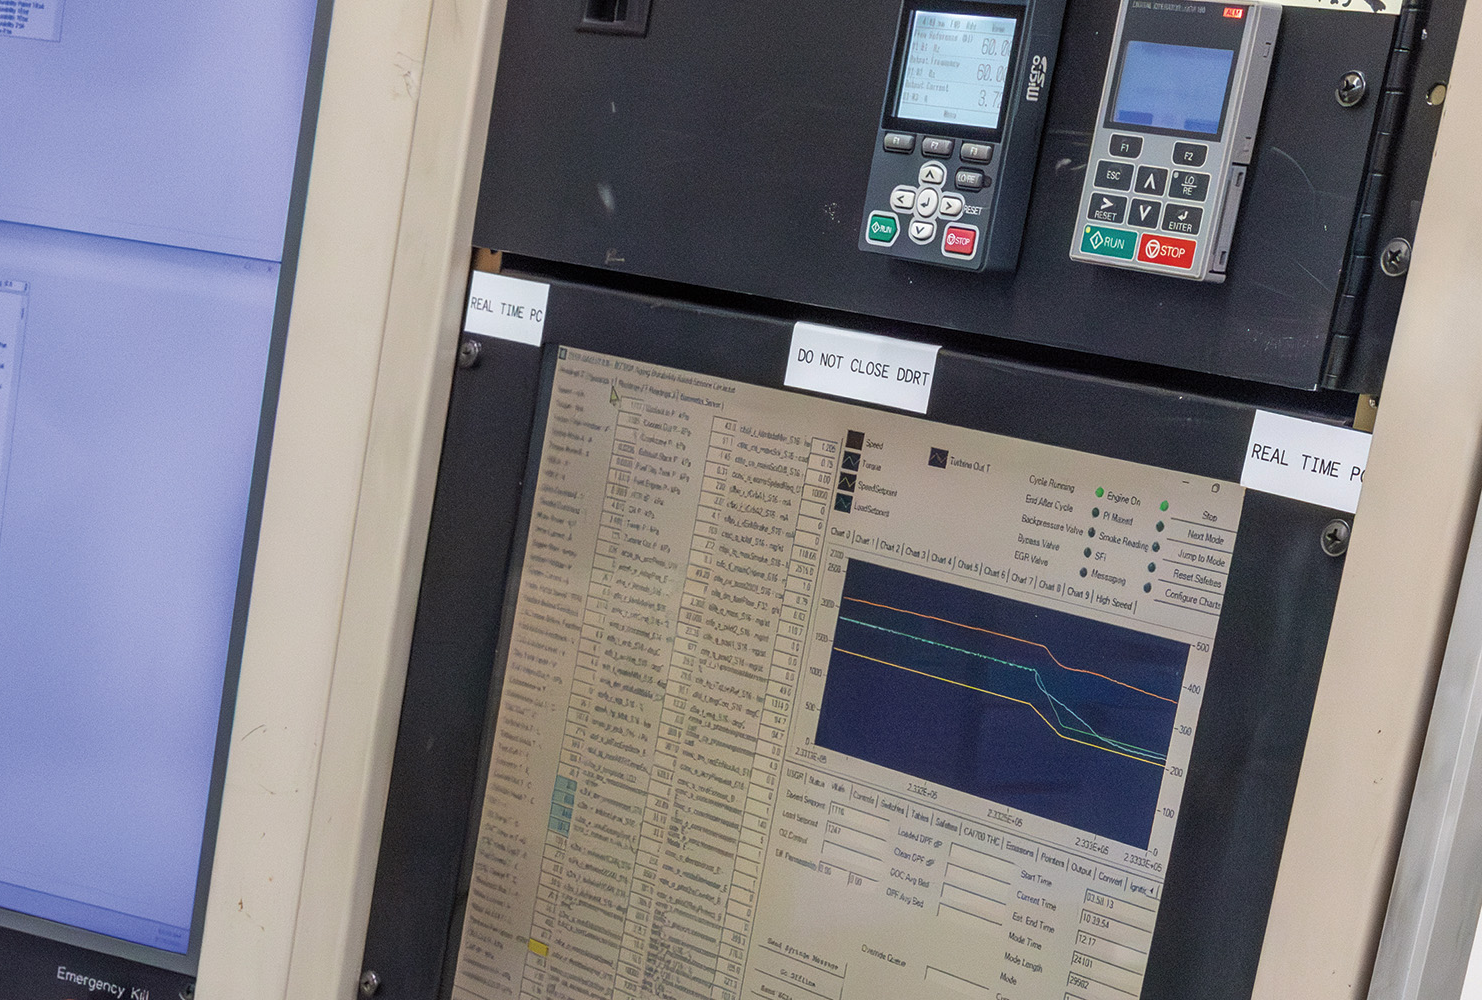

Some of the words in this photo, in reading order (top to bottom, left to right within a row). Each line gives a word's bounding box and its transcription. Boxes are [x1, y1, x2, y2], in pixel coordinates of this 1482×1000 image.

[893, 137, 900, 145] F1
[970, 147, 978, 155] F3
[1121, 144, 1129, 152] F1
[1184, 152, 1193, 160] F2
[1107, 171, 1121, 181] ESC
[1184, 176, 1195, 185] LO
[1182, 186, 1192, 196] RE
[964, 201, 982, 215] RESET
[1094, 210, 1117, 221] RESET
[880, 223, 891, 233] RUN
[1169, 222, 1192, 232] ENTER
[955, 236, 970, 245] STOP
[1104, 236, 1125, 249] RUN
[1160, 246, 1185, 258] STOP
[469, 296, 494, 314] REAL
[501, 302, 524, 319] TIME
[530, 307, 544, 324] PC
[797, 347, 815, 364] DO
[819, 352, 843, 370] NOT
[850, 358, 889, 379] CLOSE
[895, 367, 930, 387] DDRT
[866, 439, 884, 450] Speed
[862, 459, 881, 472] Torque
[1251, 443, 1289, 468] REAL
[1301, 453, 1341, 478] TIME
[1029, 475, 1047, 487] Cycle
[1049, 478, 1075, 493] Running
[1025, 494, 1038, 504] End
[1038, 496, 1053, 508] After
[1054, 501, 1074, 513] Cycle
[1107, 492, 1129, 505] Engine
[1131, 496, 1141, 506] On
[1202, 511, 1218, 522] Stop
[1022, 514, 1065, 532] Backpressure
[1066, 523, 1083, 536] Valve
[1018, 533, 1041, 548] Bypass
[1042, 538, 1060, 551] Valve
[1099, 532, 1122, 545] Smoke
[1122, 537, 1149, 553] Reading
[1187, 529, 1204, 540] Next
[1205, 534, 1225, 545] Mode
[1014, 551, 1030, 561] EGR
[1031, 554, 1049, 567] Valve
[1178, 549, 1196, 562] Jump
[1197, 553, 1205, 561] to
[1206, 556, 1225, 567] Mode
[1091, 569, 1126, 586] Messaging
[1096, 594, 1110, 605] High
[1112, 598, 1132, 611] Speed
[1165, 589, 1198, 604] Configure
[1199, 597, 1221, 610] Charts
[1197, 642, 1209, 652] 500
[1041, 852, 1064, 869] Pointers
[1071, 862, 1092, 877] Output
[1098, 872, 1123, 887] Convert
[1021, 870, 1036, 882] Start
[1037, 874, 1052, 887] Time
[1017, 890, 1040, 906] Current
[1041, 899, 1057, 911] Time
[57, 966, 125, 998] Emergency
